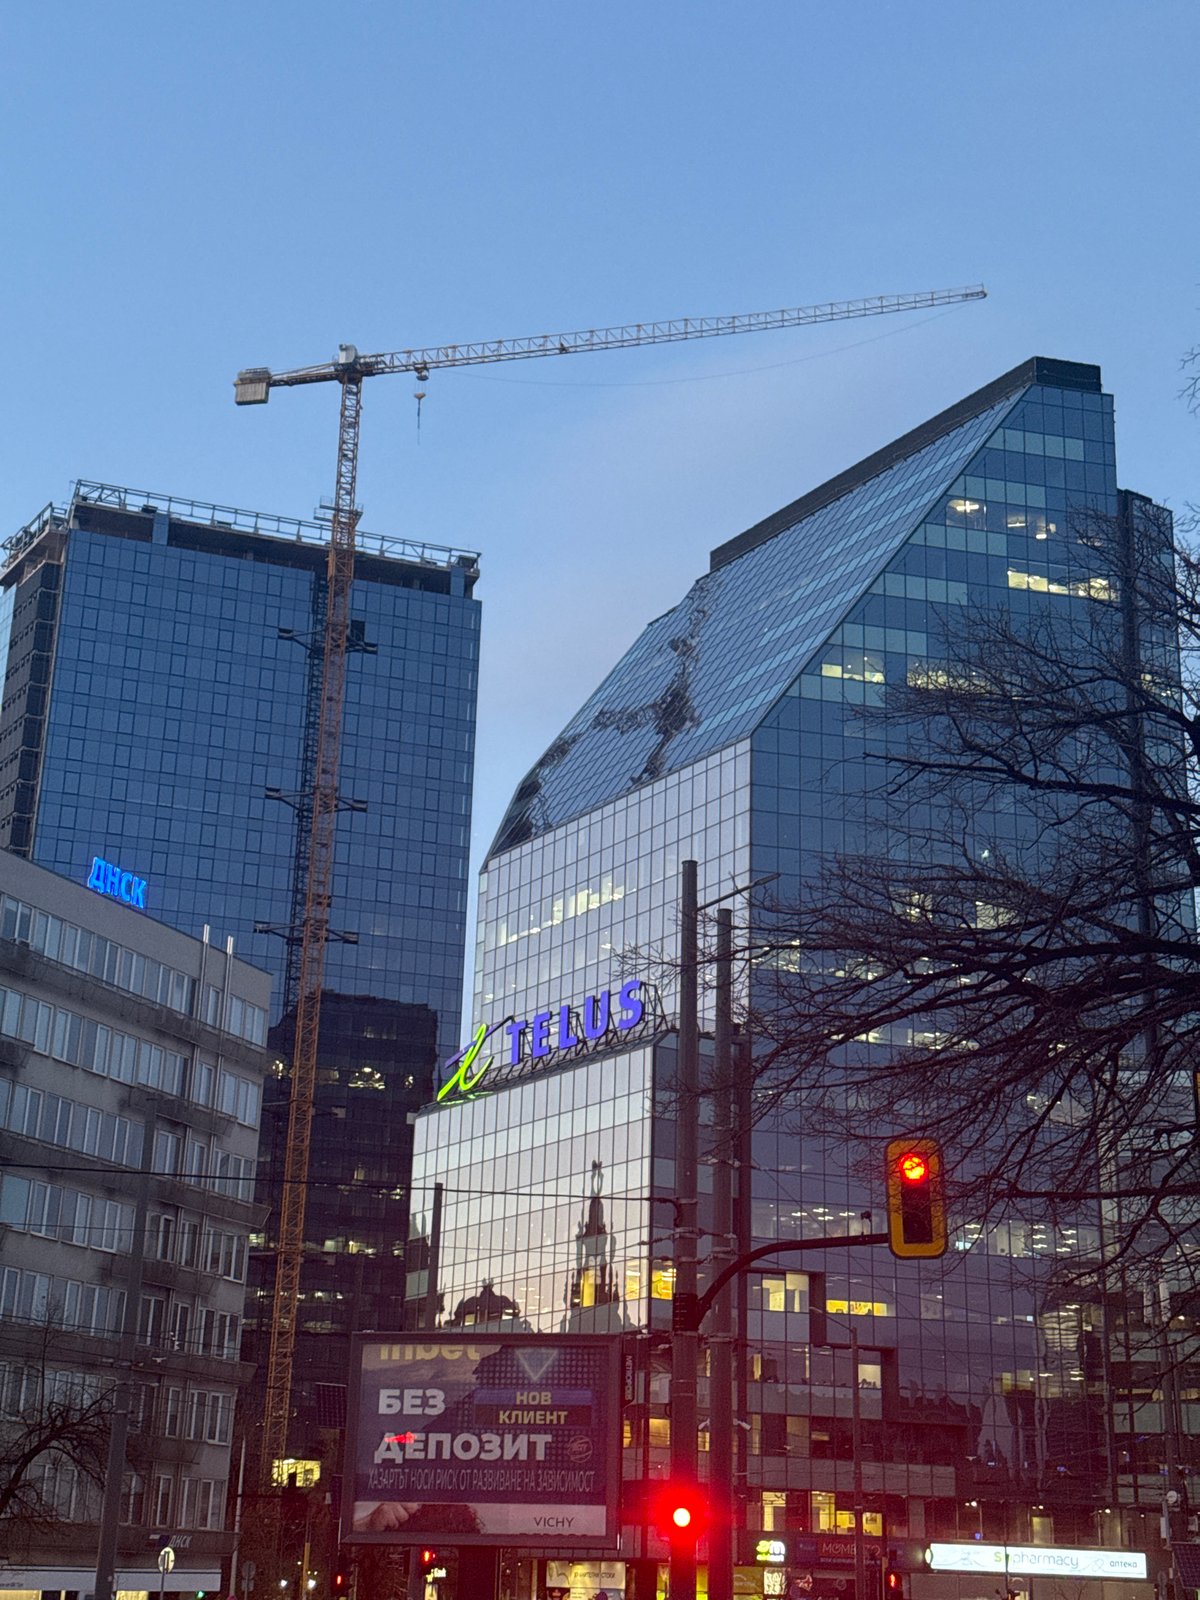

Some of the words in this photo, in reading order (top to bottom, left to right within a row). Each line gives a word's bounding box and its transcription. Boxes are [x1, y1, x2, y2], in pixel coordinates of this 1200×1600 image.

[87, 856, 147, 909] ДНСК
[506, 980, 644, 1066] TELUS
[378, 1388, 446, 1415] БЕЗ
[516, 1391, 552, 1405] НОВ
[499, 1410, 568, 1424] КЛИЕНТ
[374, 1432, 553, 1464] ДЕПОЗИТ
[368, 1467, 409, 1489] ХАЗАРТЪТ
[411, 1468, 434, 1490] НОСИ
[435, 1468, 459, 1490] РИСК
[460, 1468, 471, 1490] ОТ
[473, 1468, 522, 1490] РАЗВИВАНЕ
[523, 1469, 536, 1491] НА
[537, 1470, 595, 1492] ЗАВИСИМОСТ
[534, 1517, 575, 1527] VICHY
[822, 1543, 881, 1557] MOMETO
[1109, 1560, 1138, 1568] аптека
